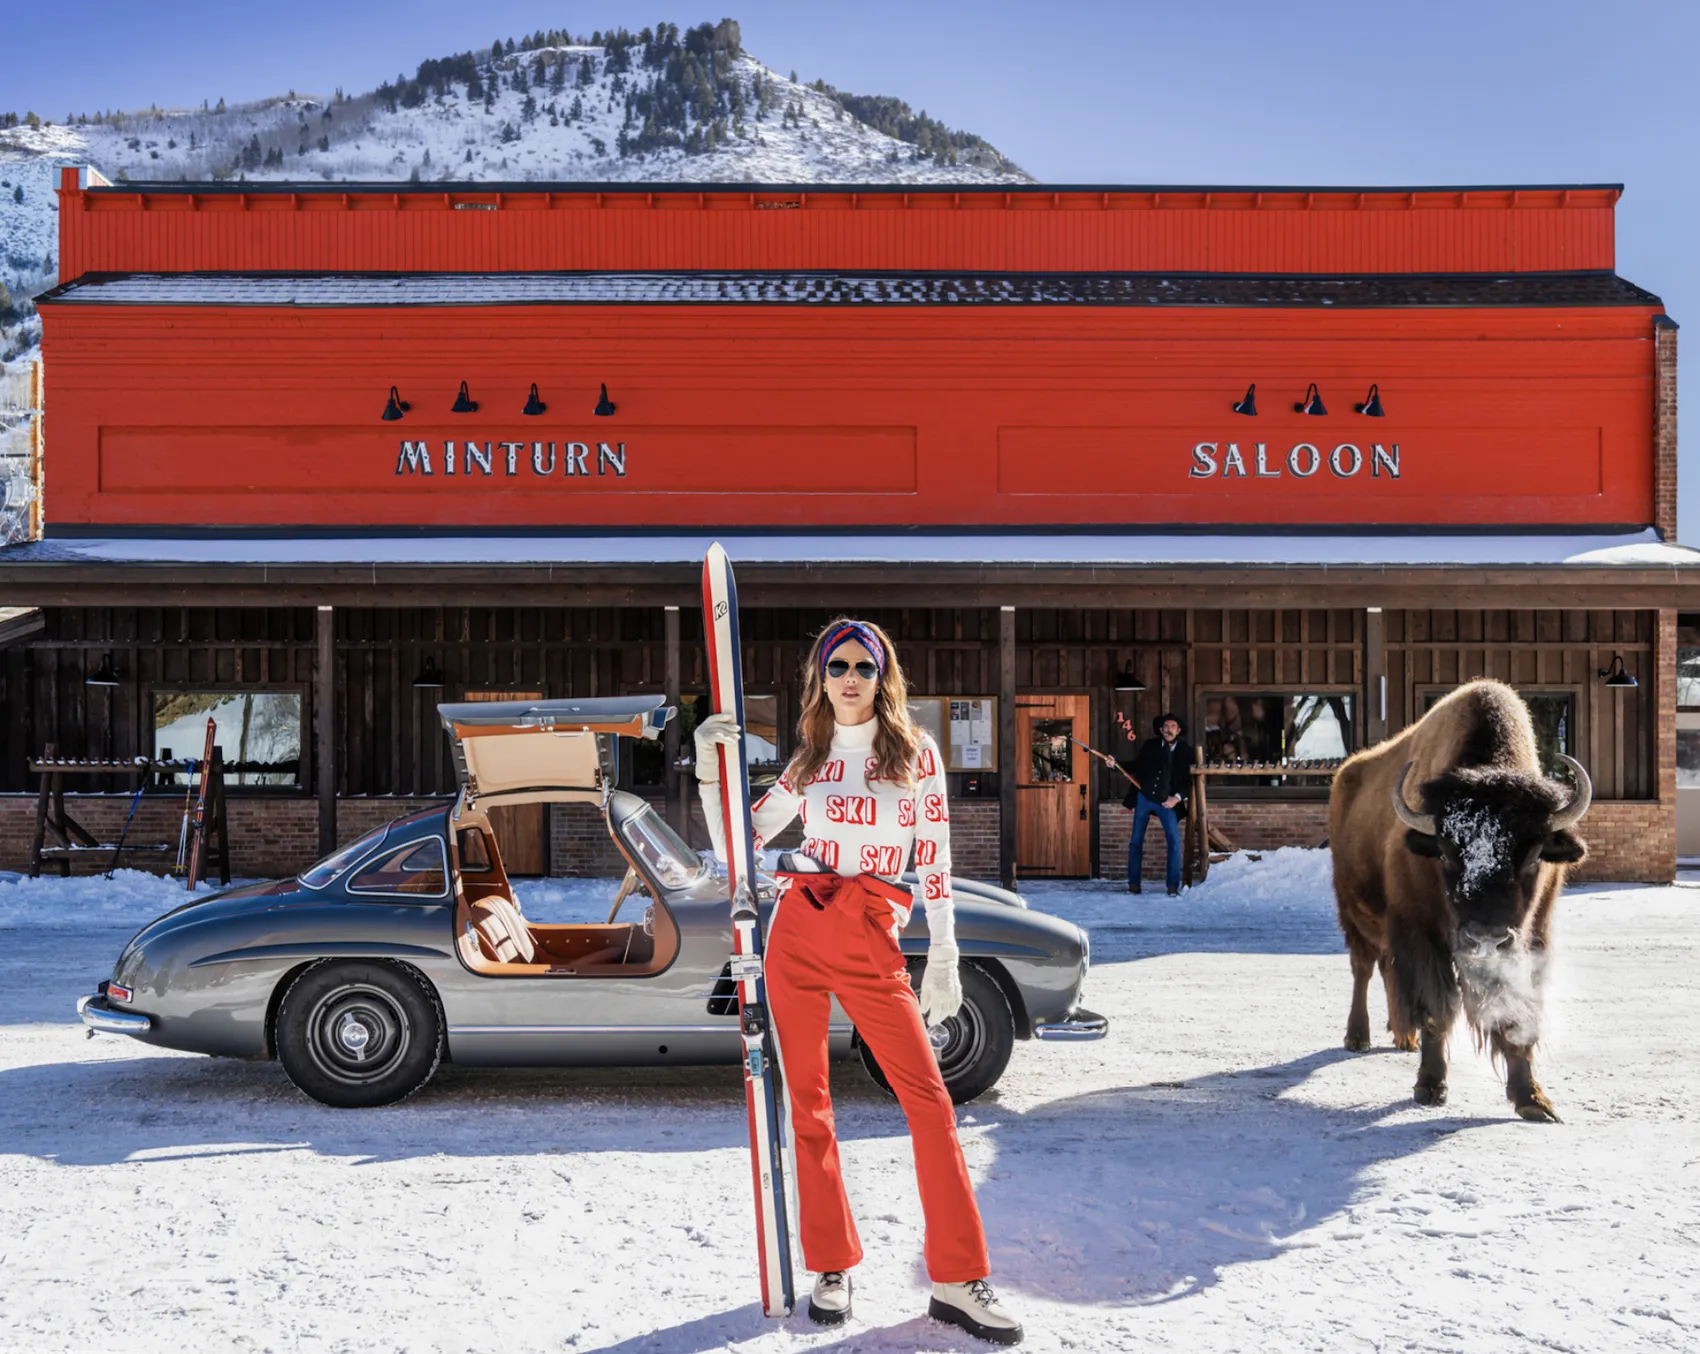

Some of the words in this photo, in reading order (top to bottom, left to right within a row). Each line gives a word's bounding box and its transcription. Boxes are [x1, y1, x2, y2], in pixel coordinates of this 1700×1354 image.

[395, 440, 628, 478] MINTURN
[1189, 442, 1400, 480] SALOON
[713, 600, 728, 621] K2
[1116, 711, 1137, 742] 146
[826, 794, 876, 826] SKI
[860, 844, 902, 876] SKI
